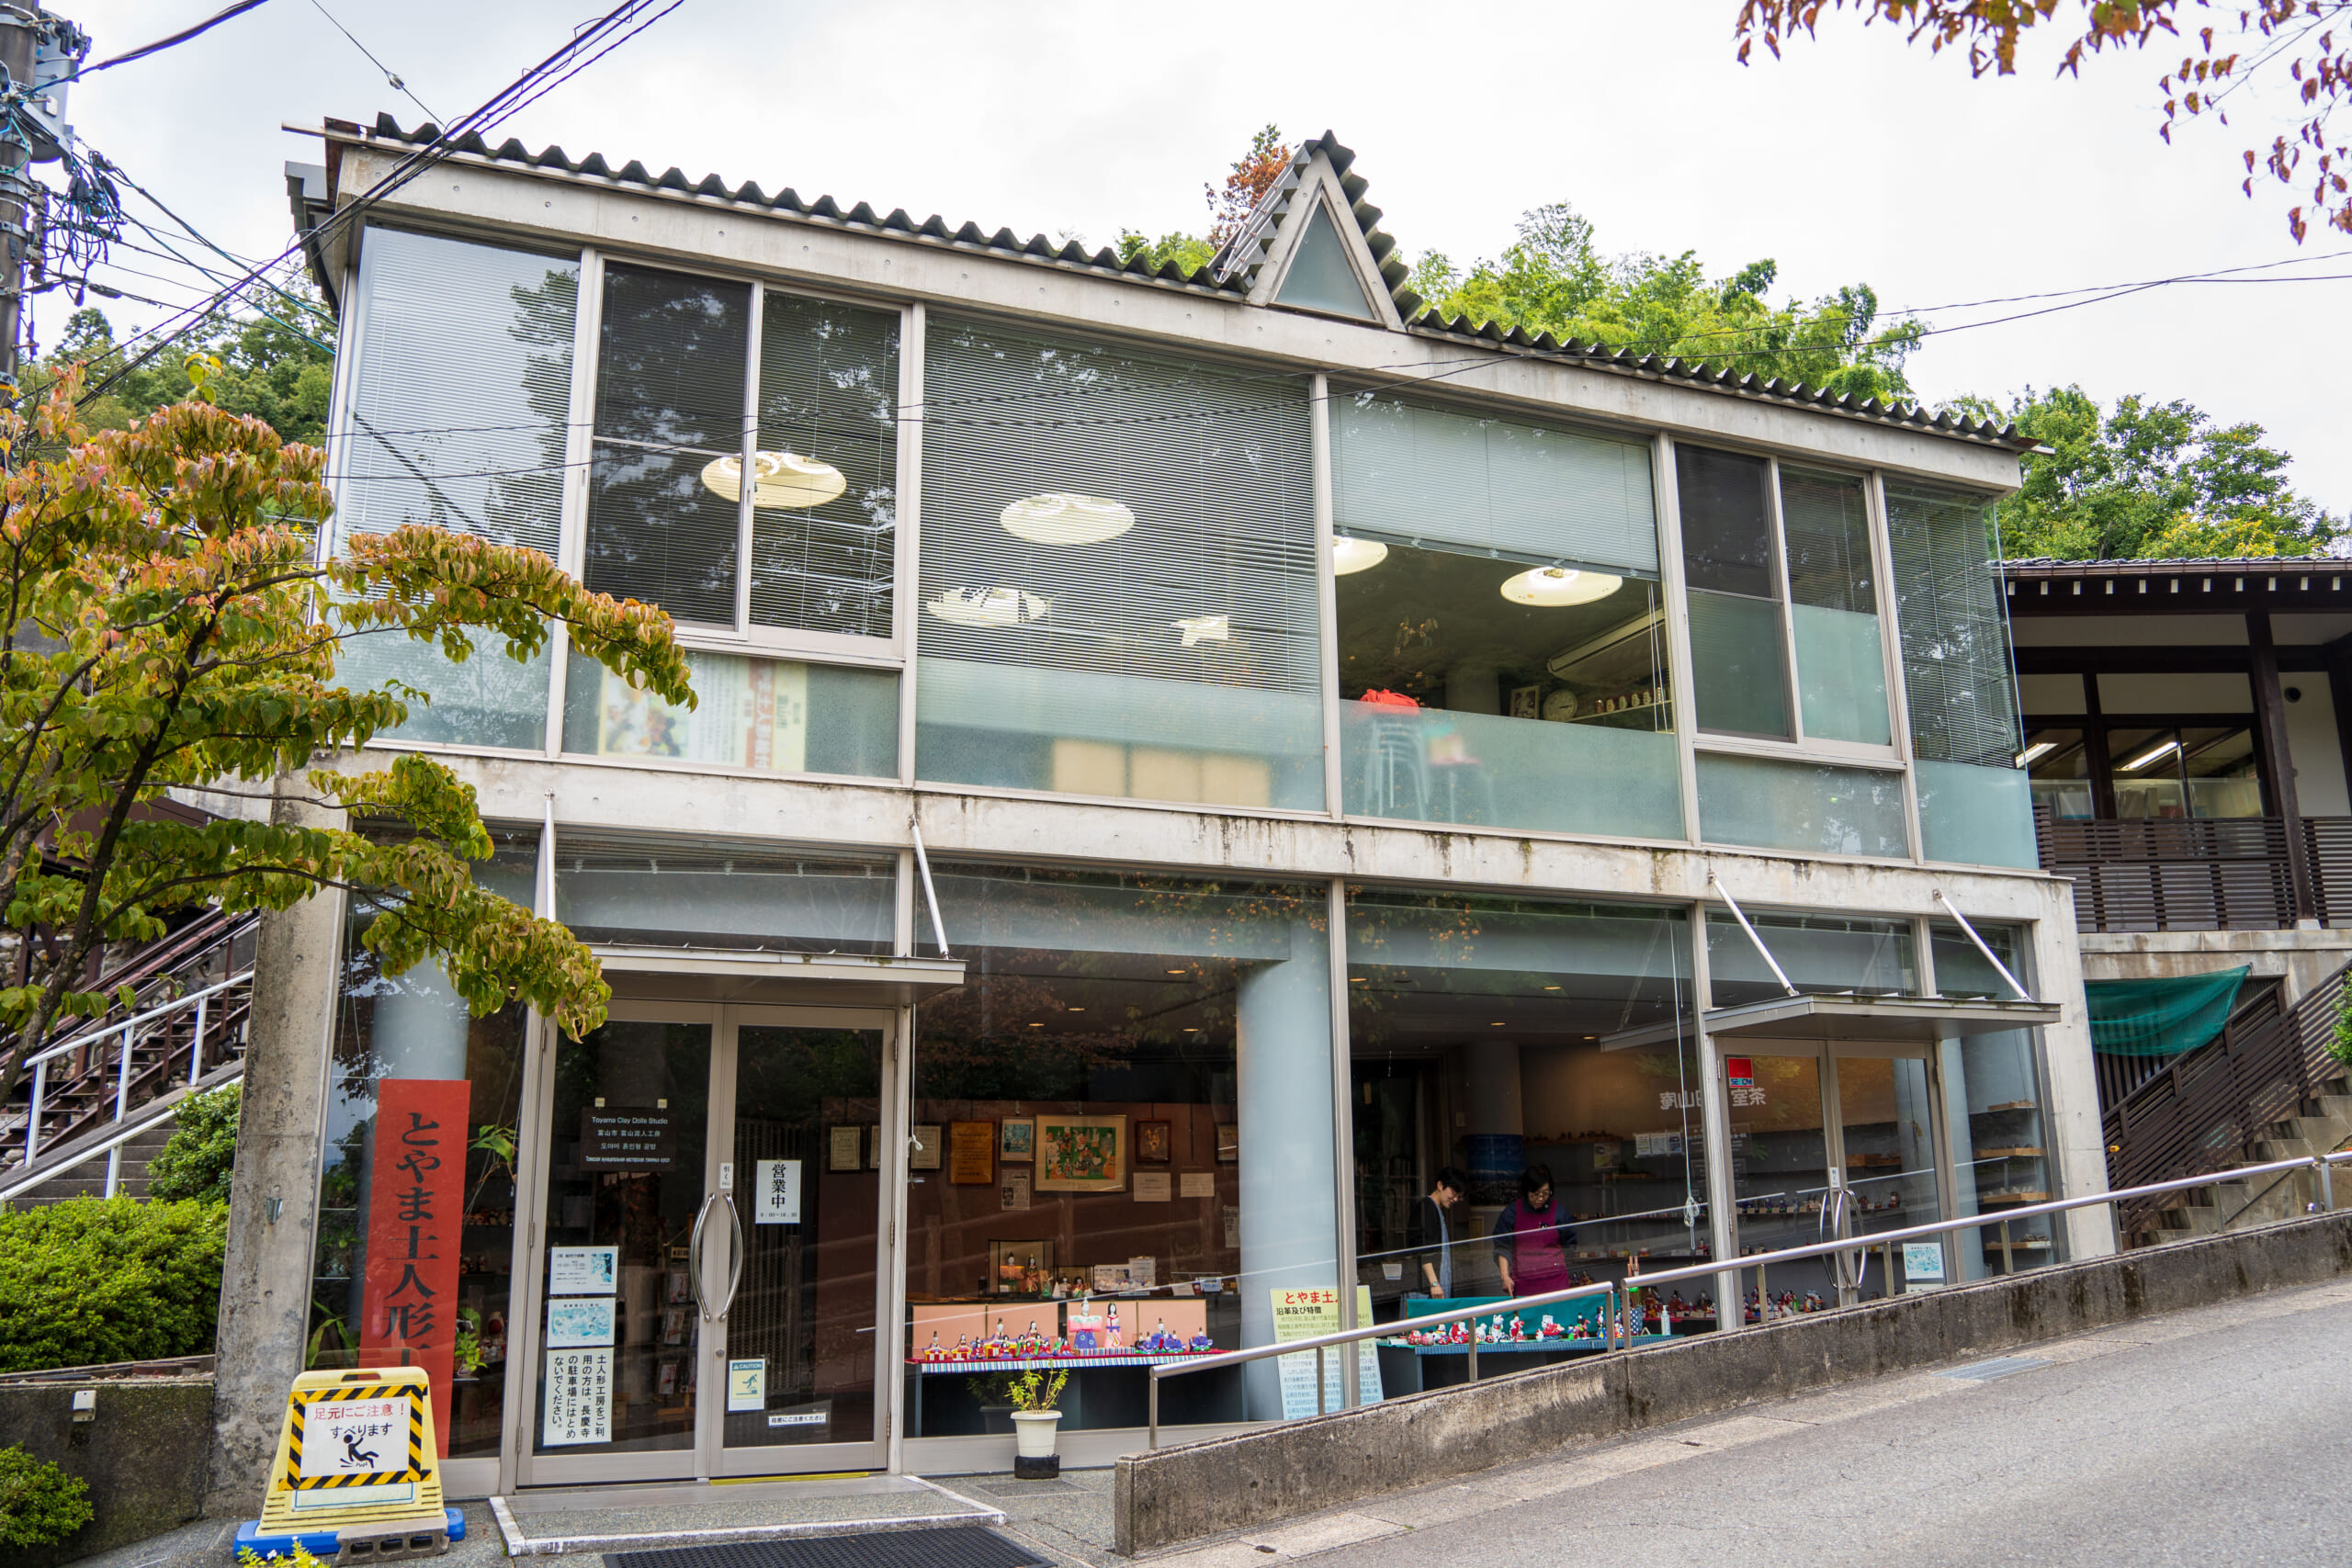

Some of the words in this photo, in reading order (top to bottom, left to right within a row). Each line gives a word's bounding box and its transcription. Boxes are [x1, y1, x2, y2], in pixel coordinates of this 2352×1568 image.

[1730, 1077, 1753, 1086] SECOM
[592, 1116, 616, 1124] Toyama
[772, 1163, 786, 1209] 営業中
[552, 1356, 563, 1428] ないでください。
[566, 1355, 578, 1438] の駐車場にはとめ
[595, 1354, 606, 1438] 土人形工房をご利
[331, 1423, 393, 1439] すべります
